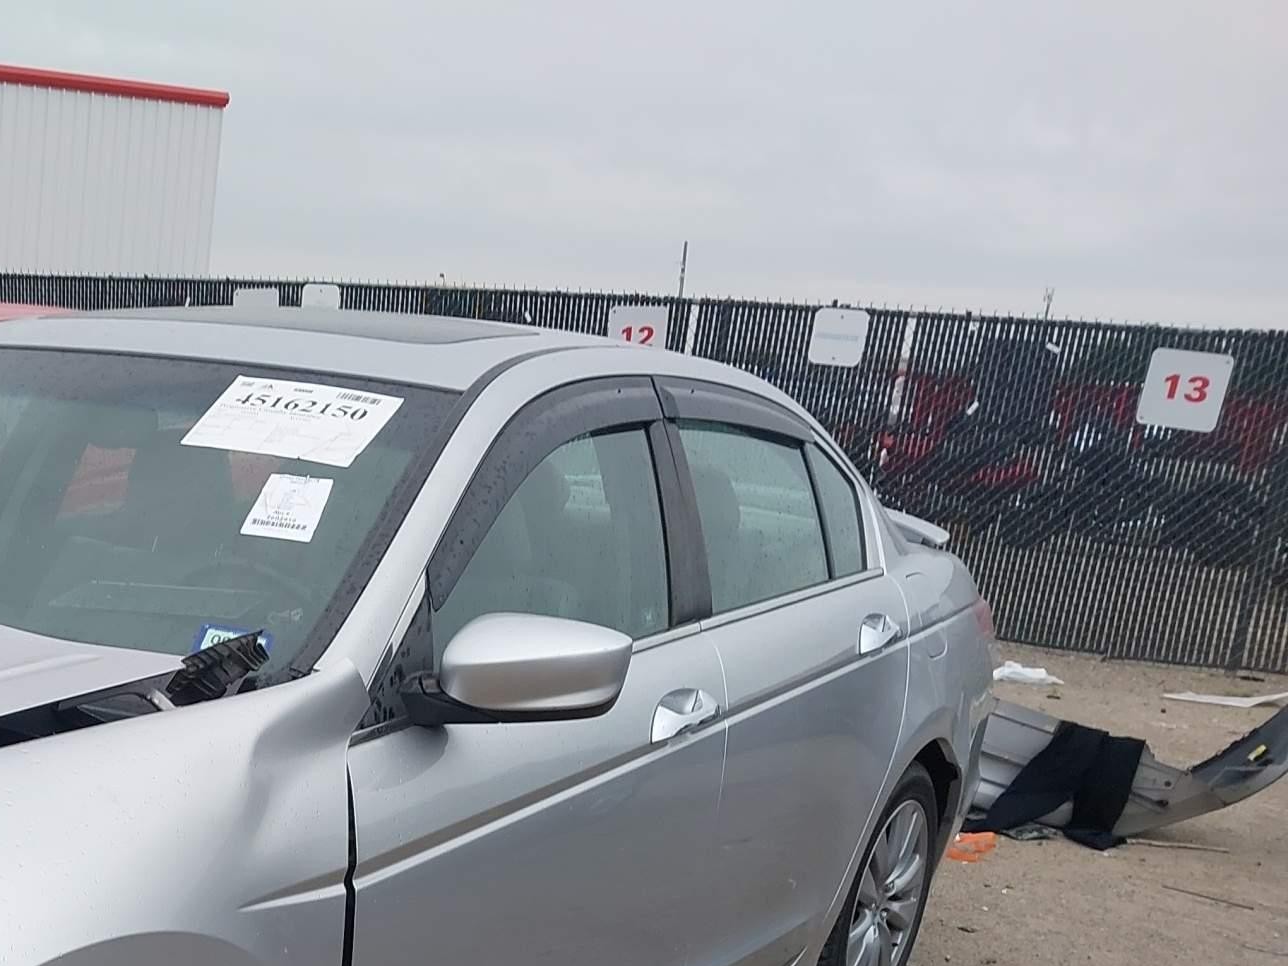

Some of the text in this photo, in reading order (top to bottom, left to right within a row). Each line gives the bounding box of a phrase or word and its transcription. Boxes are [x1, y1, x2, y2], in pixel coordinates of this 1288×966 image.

[621, 326, 655, 347] 12
[1164, 373, 1210, 403] 13
[235, 392, 368, 421] 45162150
